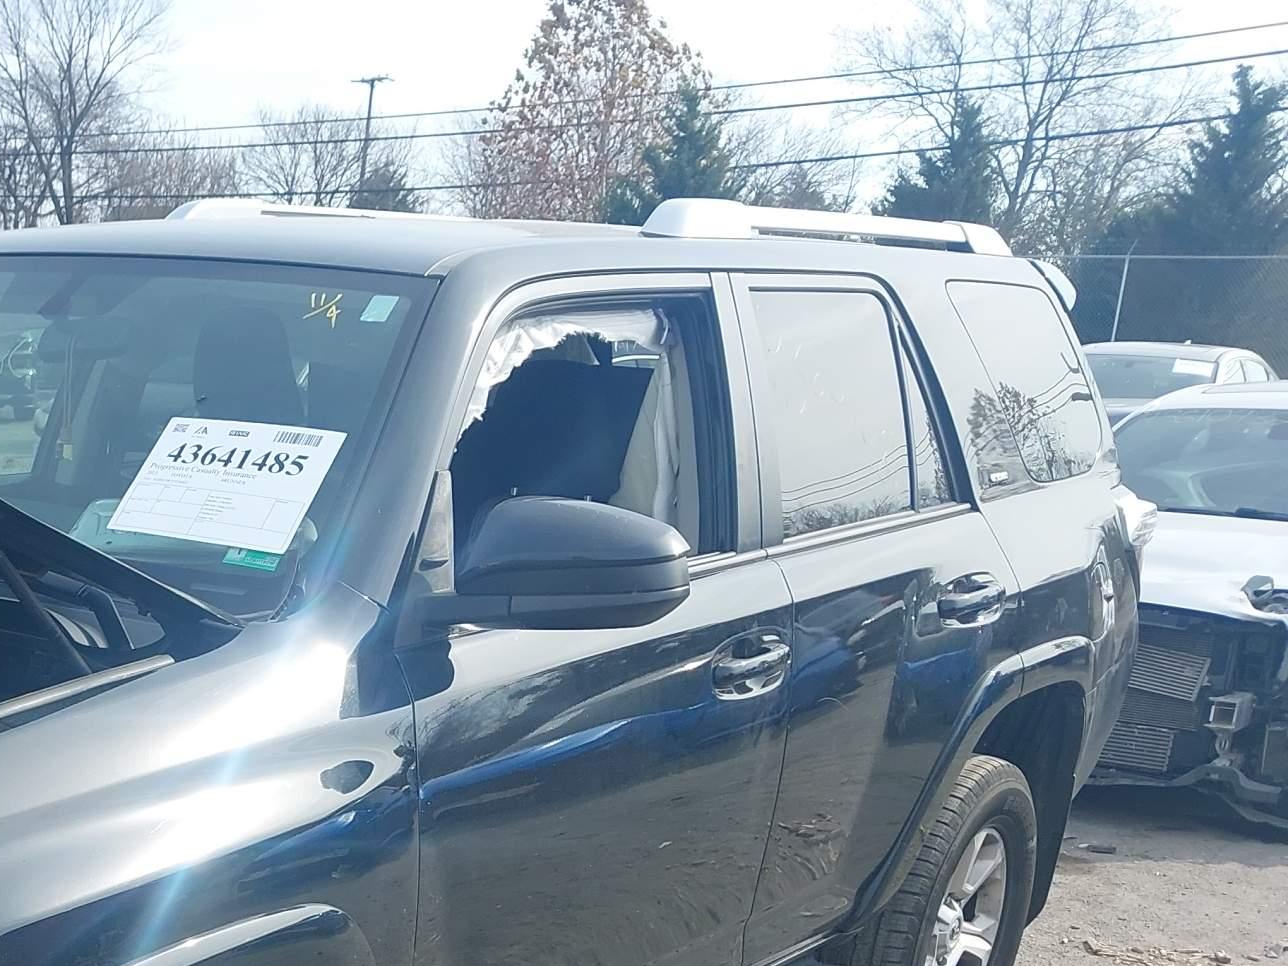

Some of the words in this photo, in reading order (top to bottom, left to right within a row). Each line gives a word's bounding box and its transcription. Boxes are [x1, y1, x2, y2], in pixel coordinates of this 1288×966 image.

[149, 462, 190, 473] Progressive
[191, 466, 220, 477] Casualty
[222, 469, 258, 480] Insurance
[166, 442, 310, 476] 43641485
